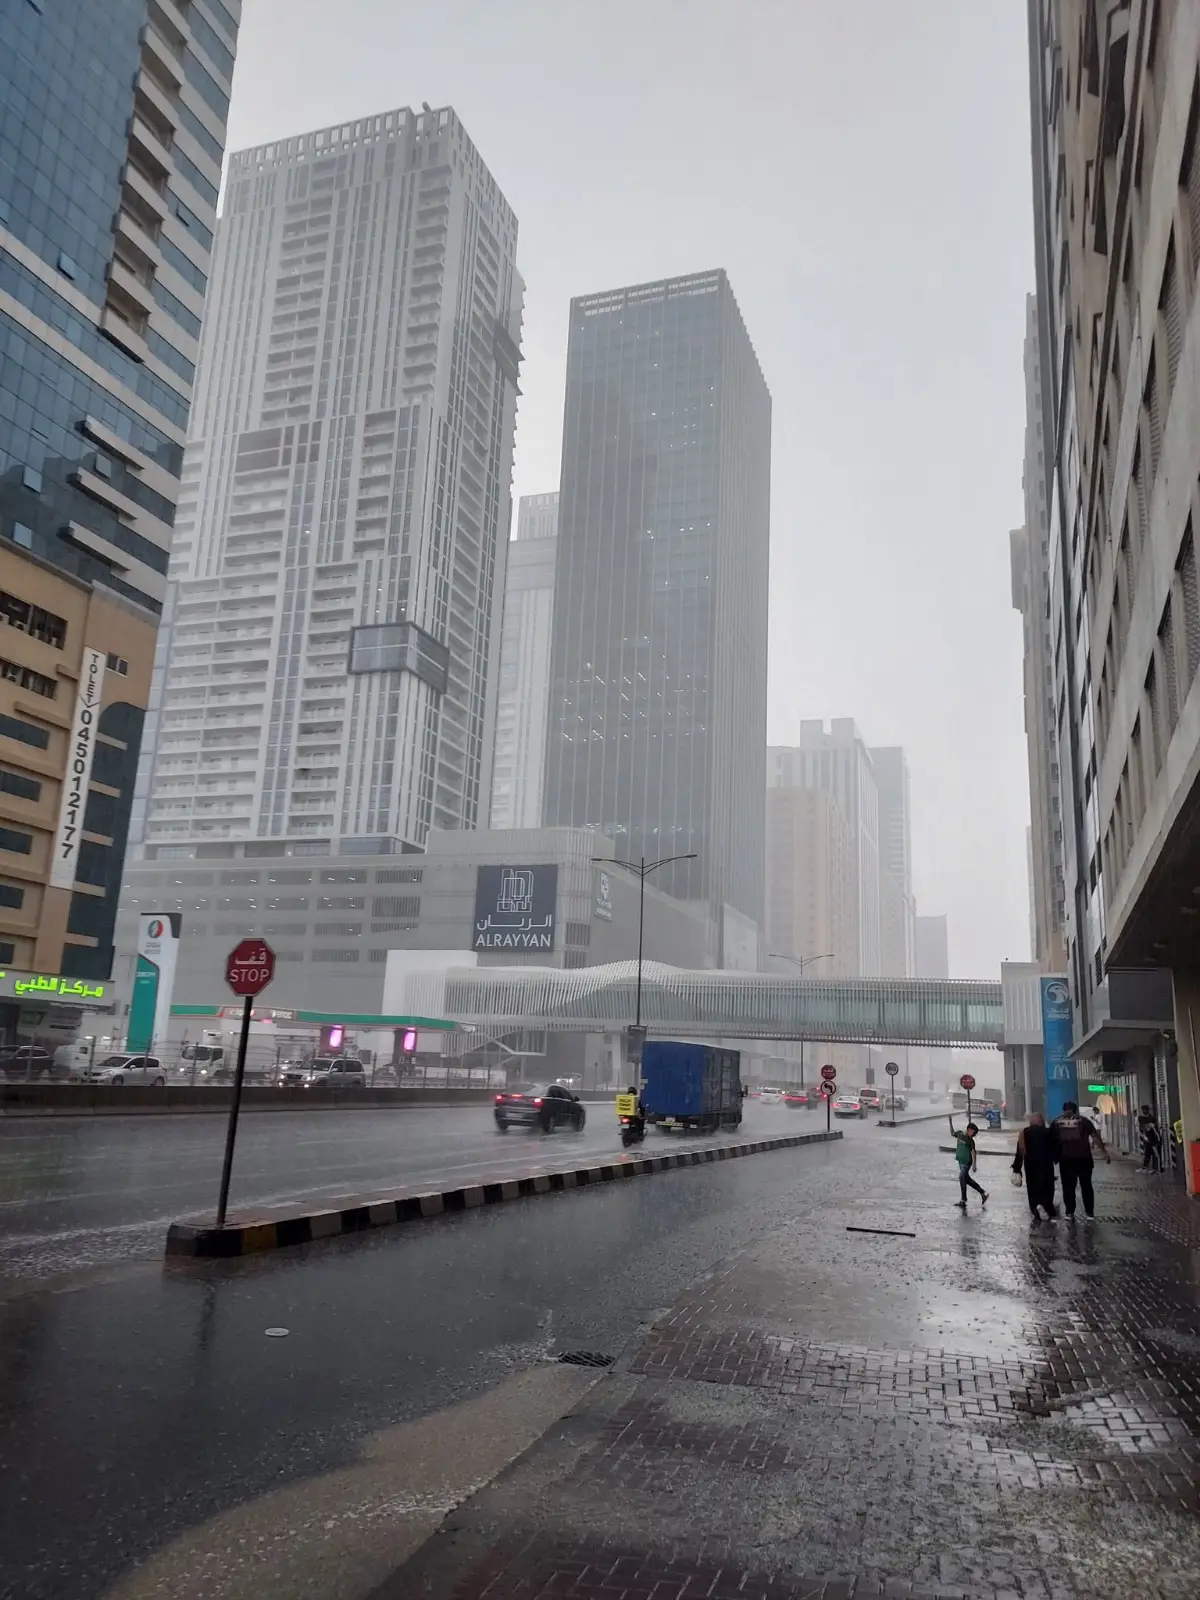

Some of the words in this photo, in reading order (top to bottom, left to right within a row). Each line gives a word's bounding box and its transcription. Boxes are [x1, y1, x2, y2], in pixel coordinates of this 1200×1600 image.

[61, 709, 93, 859] 045012177
[476, 914, 552, 931] الريان
[475, 933, 551, 948] ALRAYYAN
[235, 947, 267, 965] قف
[229, 968, 270, 982] STOP
